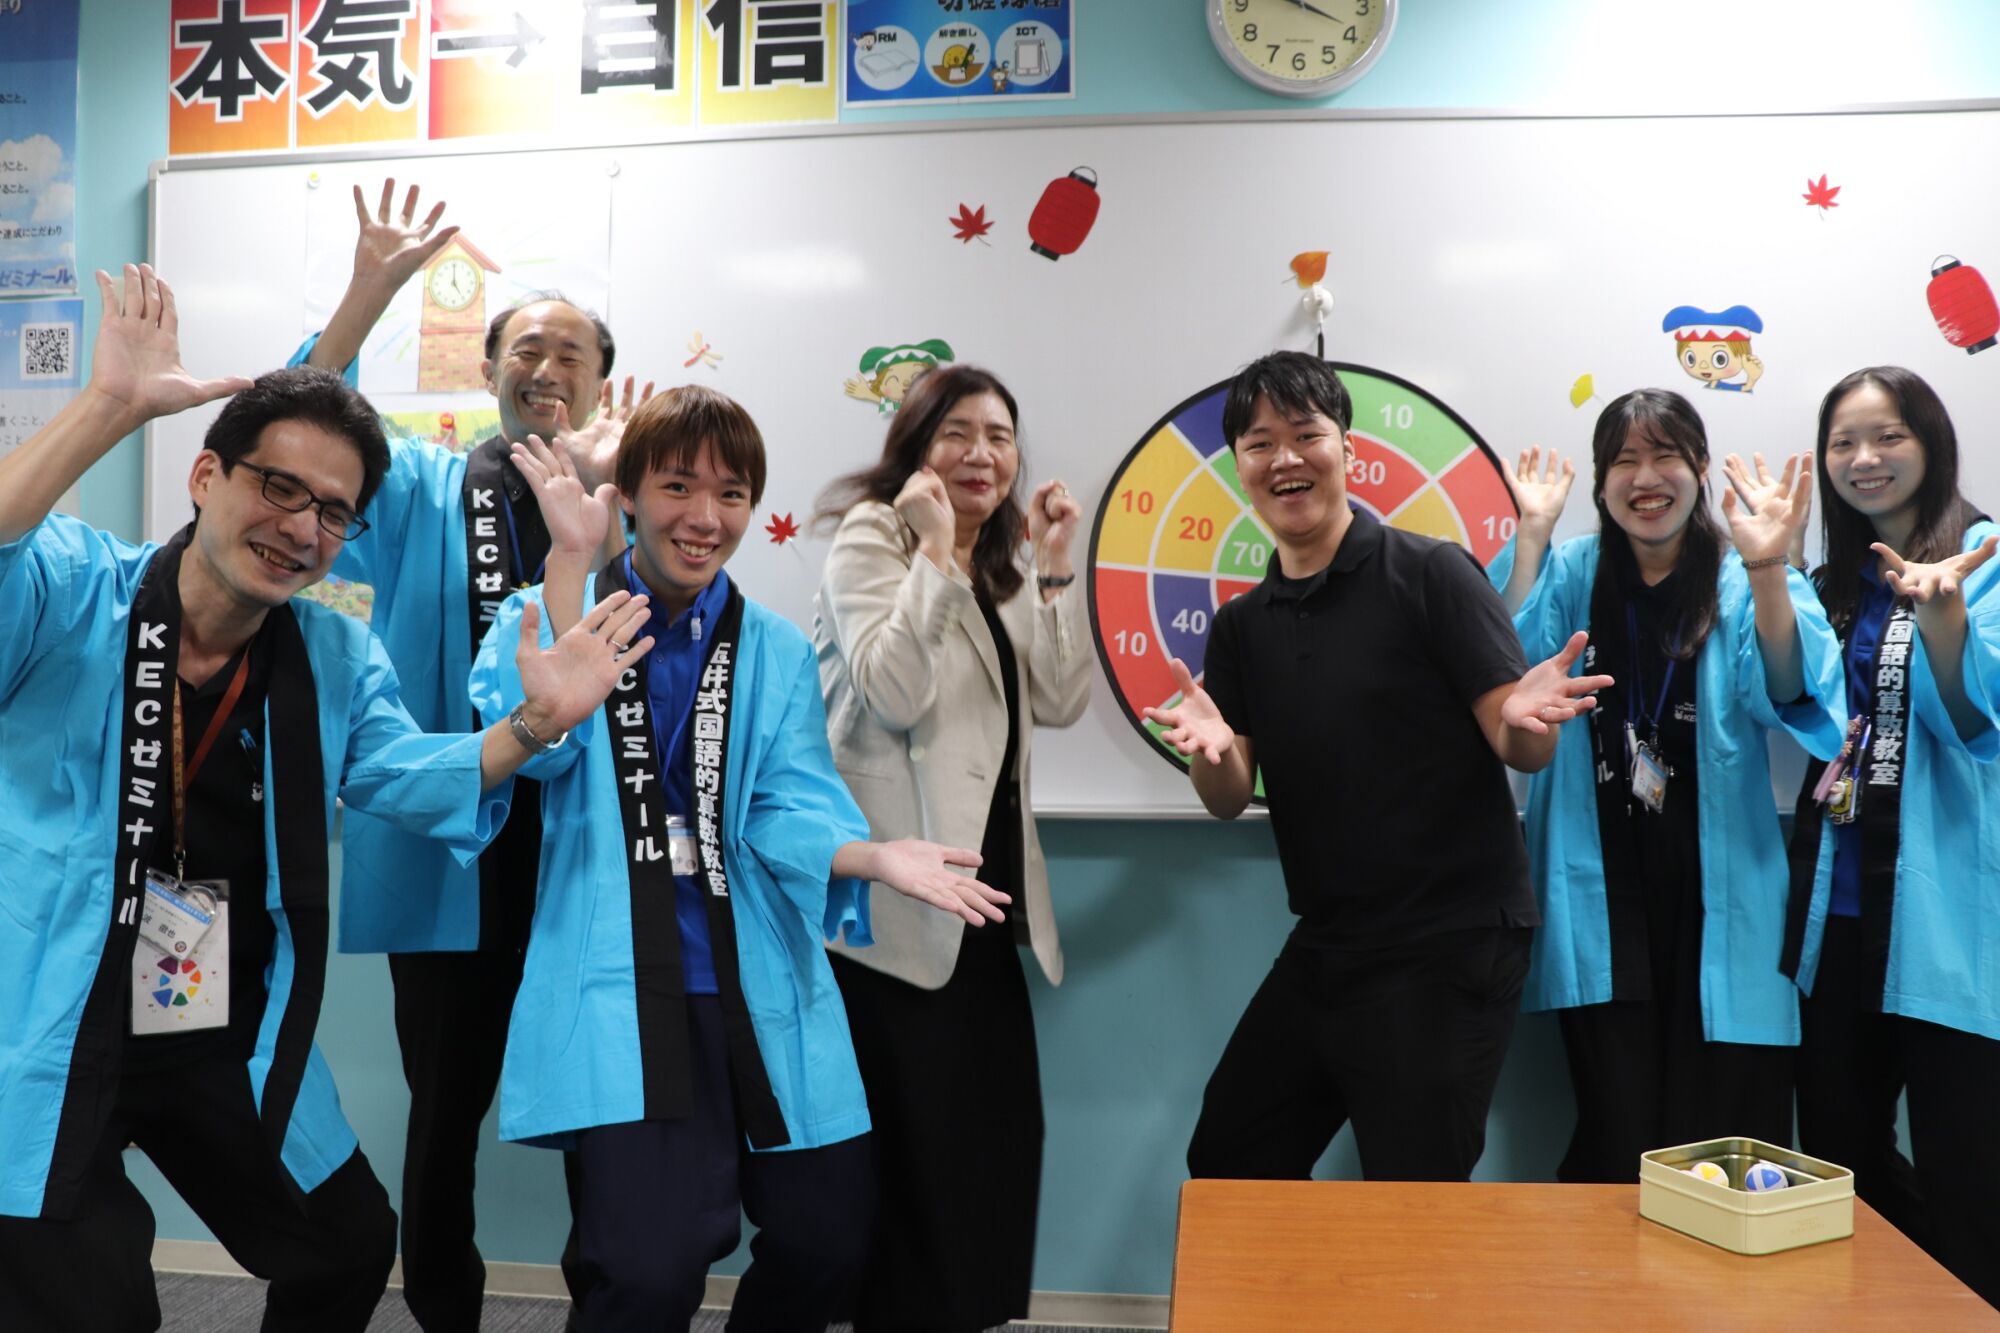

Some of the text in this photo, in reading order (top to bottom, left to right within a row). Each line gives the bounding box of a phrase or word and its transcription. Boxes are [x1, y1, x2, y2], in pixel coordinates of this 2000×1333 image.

[1235, 0, 1248, 12] 9
[1356, 0, 1369, 16] 3
[1016, 26, 1038, 37] ICT
[1243, 23, 1258, 42] 8
[1343, 25, 1358, 44] 4
[1266, 44, 1280, 63] 7
[1292, 53, 1306, 71] 6
[1321, 46, 1336, 65] 5
[0, 160, 28, 172] うこと。
[0, 184, 29, 194] ること。
[0, 225, 62, 240] 達成にこだわり
[1380, 404, 1414, 430] 10
[0, 435, 23, 446] こと
[1351, 459, 1386, 486] 30
[1120, 489, 1154, 515] 10
[1178, 515, 1214, 542] 20
[1482, 515, 1517, 541] 10
[1232, 540, 1266, 567] 70
[473, 488, 503, 645] KECゼミ
[1171, 608, 1207, 635] 40
[1114, 630, 1148, 657] 10
[615, 645, 665, 862] Cゼミナール
[118, 621, 168, 925] KECゼミナール
